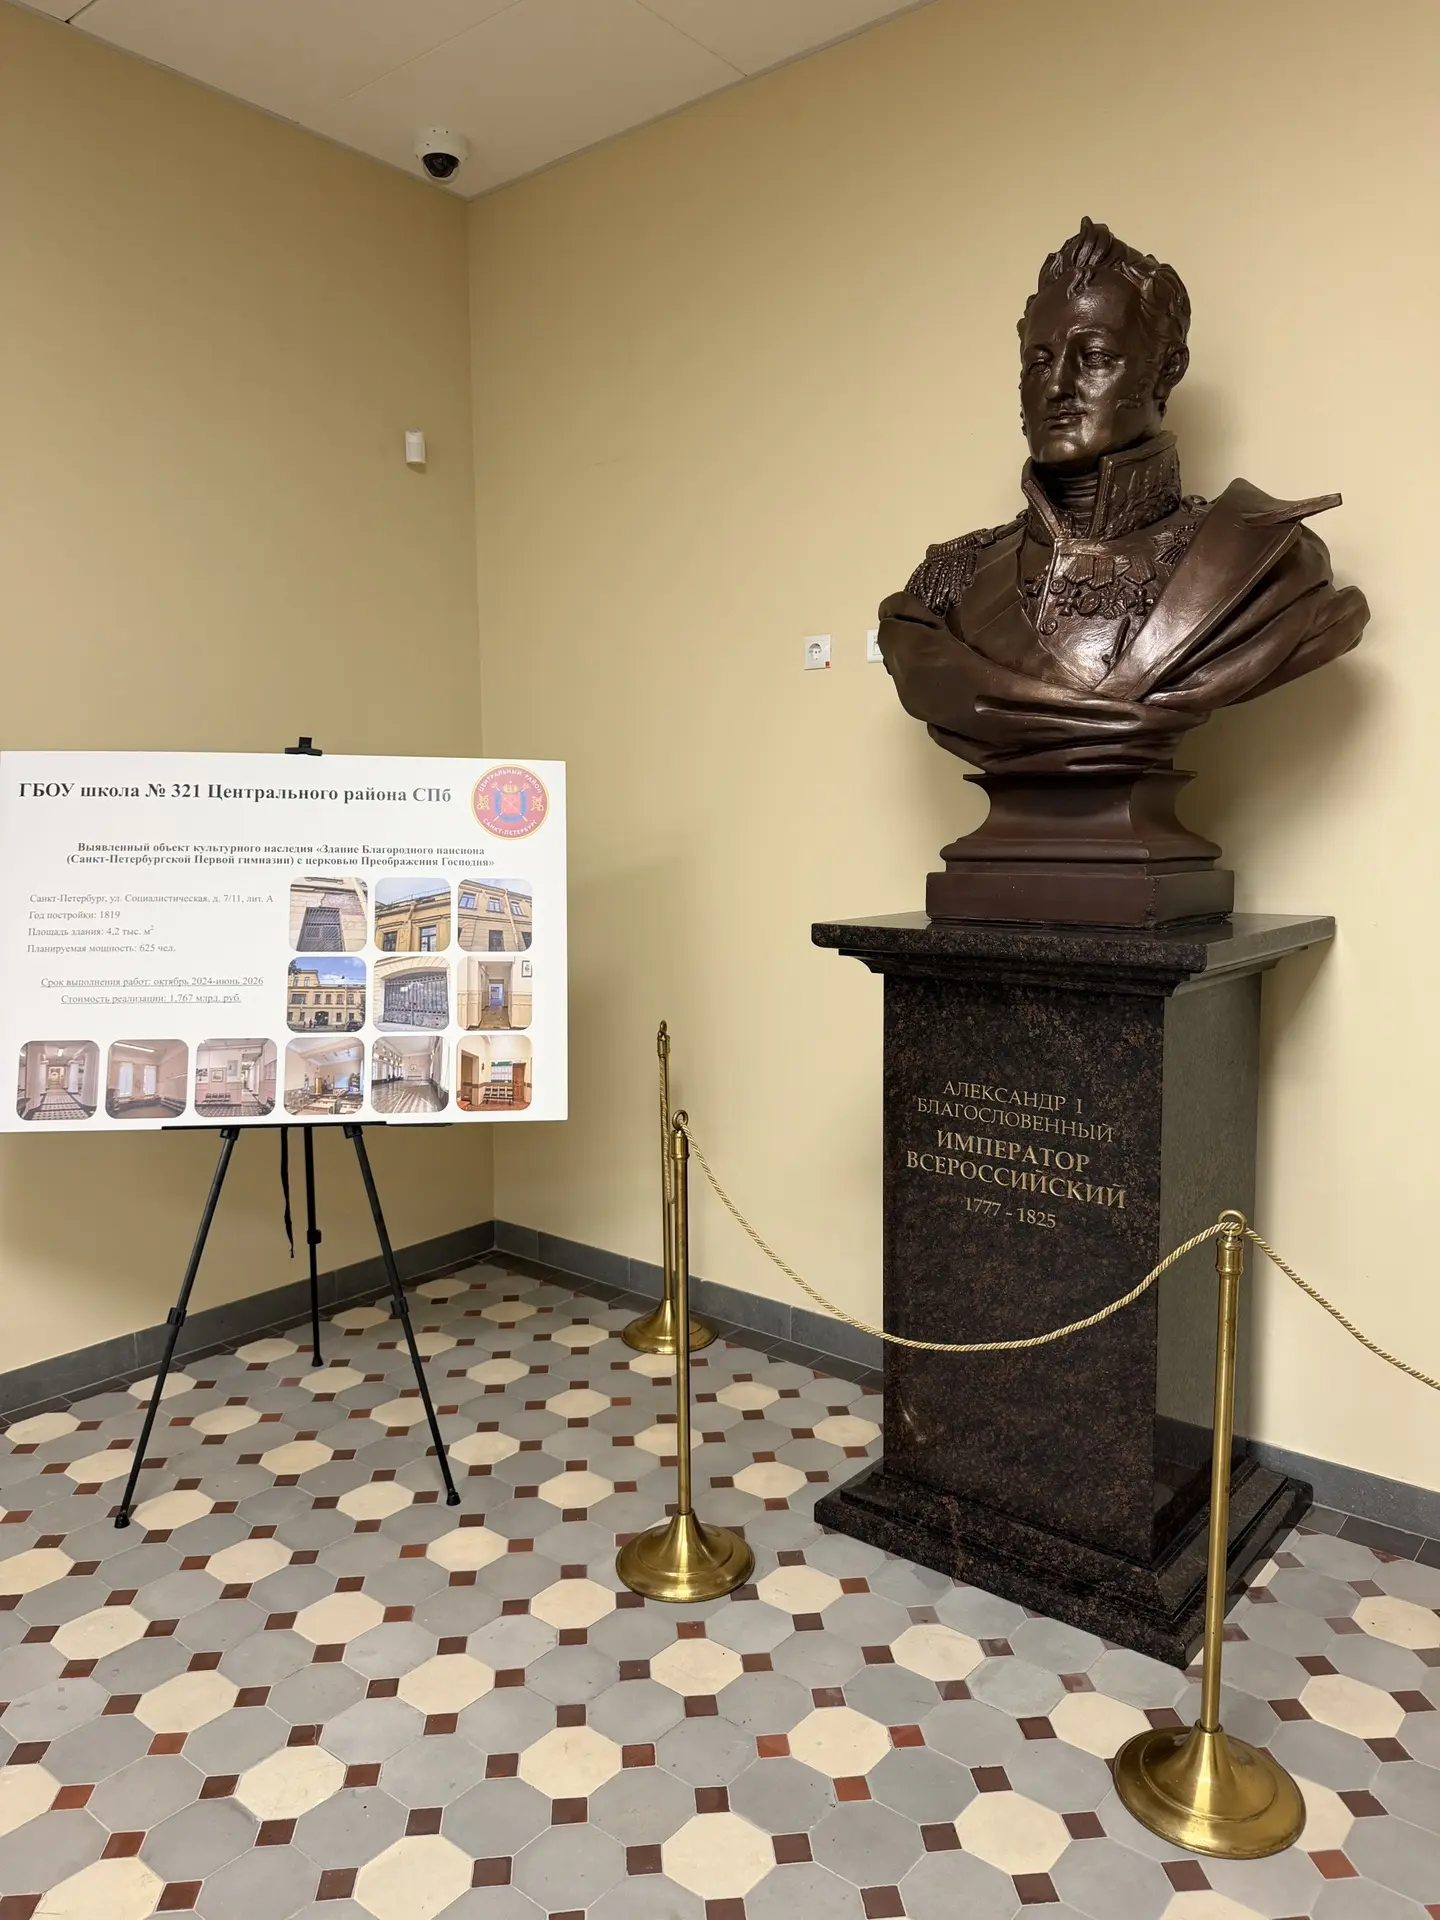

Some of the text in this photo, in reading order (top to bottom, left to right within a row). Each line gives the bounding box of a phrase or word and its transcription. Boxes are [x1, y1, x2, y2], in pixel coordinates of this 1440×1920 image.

[19, 783, 451, 803] ГБОУ школа № 321 Центрального района СПб
[78, 842, 150, 852] Выявленный
[153, 844, 190, 852] объект
[194, 844, 261, 855] культурного
[264, 846, 313, 854] наследия
[316, 845, 359, 854] «Здание
[362, 845, 433, 856] Благородного
[67, 854, 190, 866] (Санкт-Петербургской
[194, 854, 235, 866] Первой
[238, 856, 294, 866] гимназии)
[306, 858, 358, 867] церковью
[361, 857, 438, 867] Преображения
[442, 858, 494, 867] Господня»
[30, 894, 107, 904] Санкт-Петербург,
[110, 896, 122, 904] ул.
[124, 894, 209, 904] Социалистическая,
[224, 894, 244, 904] 7/11,
[29, 911, 120, 920] Год постройки: 1819
[28, 927, 69, 936] Площадь
[27, 944, 86, 953] Планируемая
[139, 944, 155, 952] 625
[40, 978, 64, 988] Срок
[123, 978, 150, 986] работ:
[153, 978, 189, 986] октябрь
[192, 977, 240, 986] 2024-июнь
[242, 976, 264, 985] 2026
[943, 1080, 1066, 1112] АЛЕКСАНДР
[917, 1098, 1114, 1143] БЛАГОСЛОВЕННЫЙ
[937, 1130, 1090, 1173] ИМПЕРАТОР
[906, 1150, 1127, 1209] ВСЕРОССИЙСКИЙ
[966, 1198, 1002, 1216] 1777
[1017, 1208, 1056, 1229] 1825
